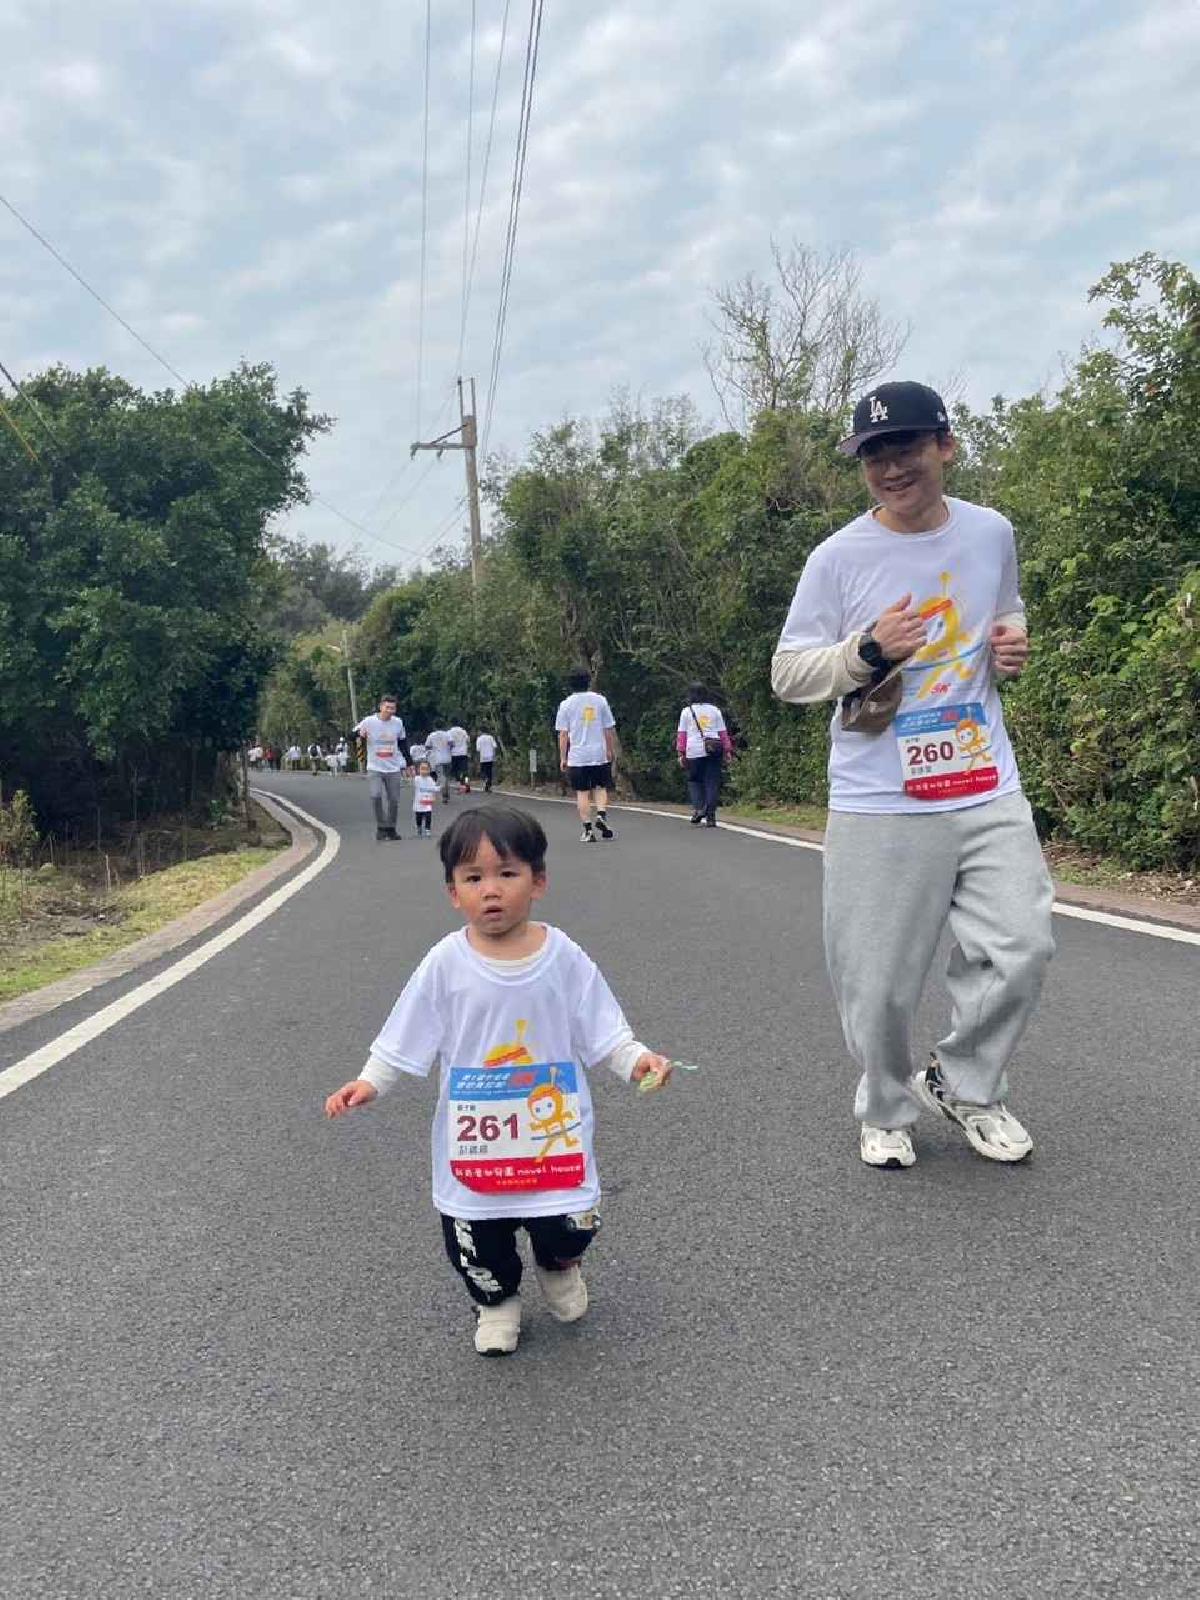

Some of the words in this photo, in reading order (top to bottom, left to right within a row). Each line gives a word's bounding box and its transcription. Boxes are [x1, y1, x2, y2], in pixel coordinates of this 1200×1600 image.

[869, 396, 889, 423] LA
[907, 741, 953, 766] 260
[457, 1113, 518, 1142] 261
